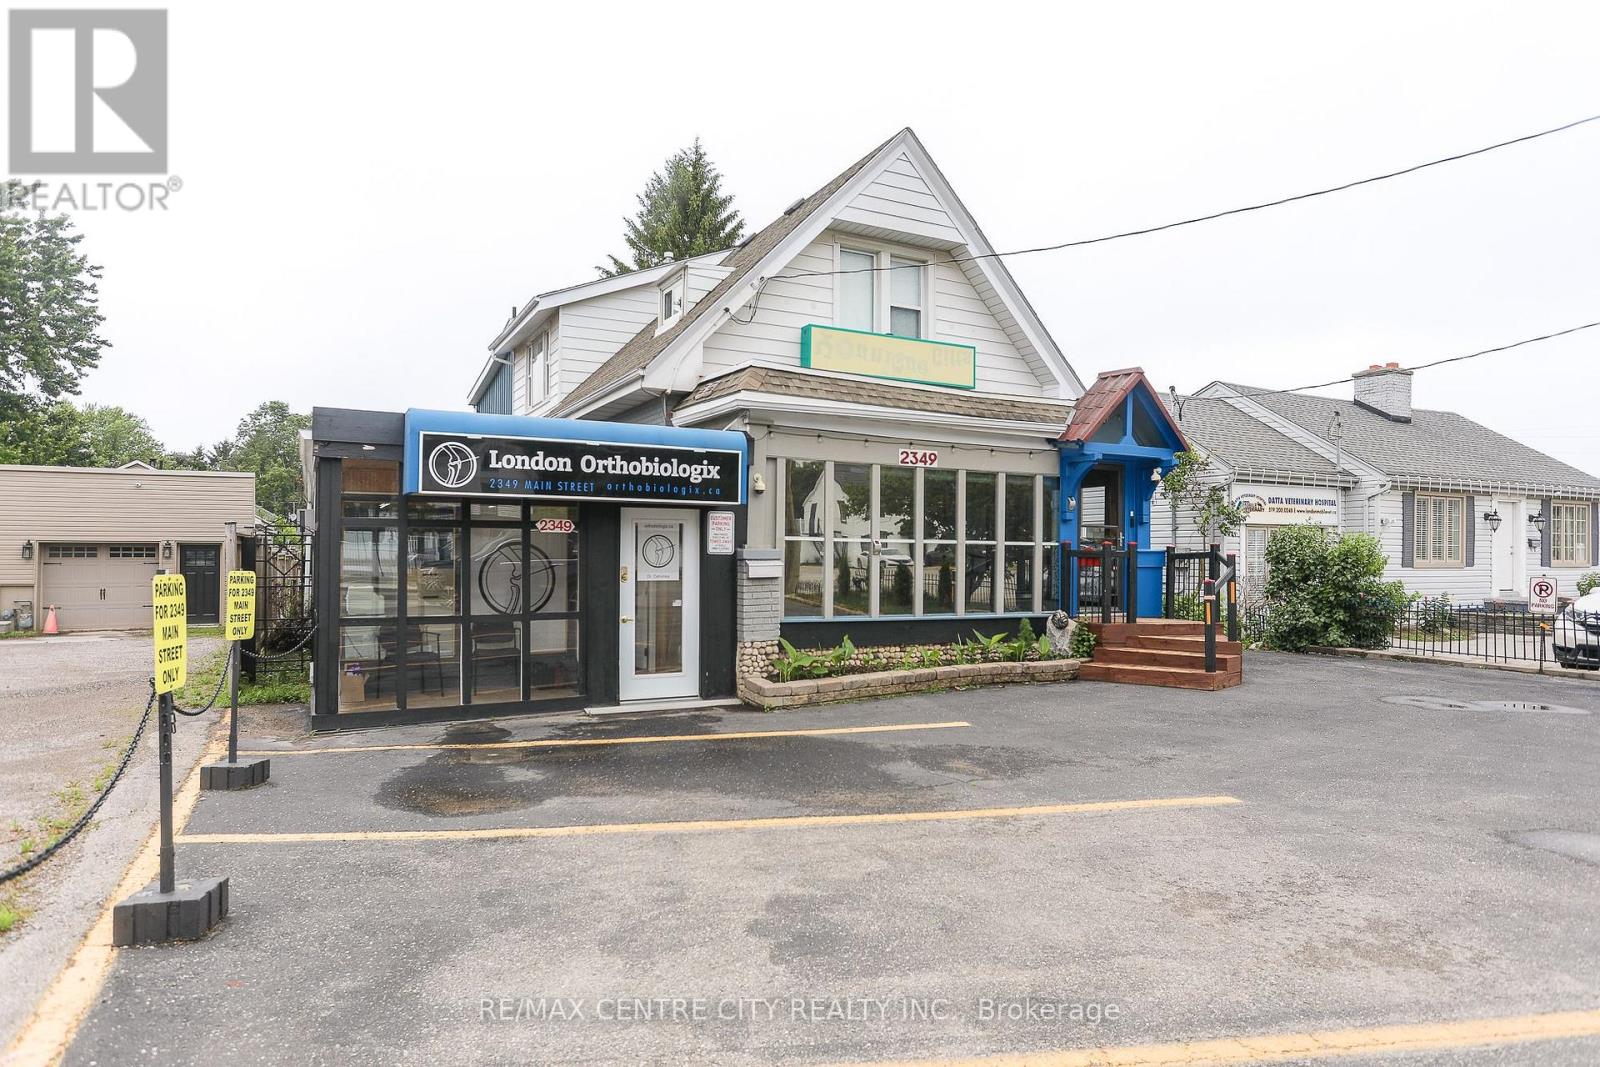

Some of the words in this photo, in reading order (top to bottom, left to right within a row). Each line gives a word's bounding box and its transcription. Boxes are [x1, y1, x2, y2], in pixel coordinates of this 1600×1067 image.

[900, 451, 937, 466] 2349
[489, 449, 572, 472] London
[580, 452, 721, 483] Orthobiologix
[489, 478, 518, 489] 2349
[524, 479, 553, 491] MAIN
[558, 481, 595, 492] STREET
[607, 481, 721, 496] orthobiologix.ca
[1284, 497, 1313, 505] VETERINARY
[1314, 498, 1337, 506] HOSPITAL
[539, 520, 572, 531] 2349
[229, 575, 254, 585] PARKING
[155, 582, 184, 598] PARKING
[228, 588, 240, 597] FOR
[241, 588, 254, 597] 2349
[155, 605, 168, 620] FOR
[169, 602, 185, 618] 2349
[234, 601, 249, 610] MAIN
[230, 613, 252, 623] STREET
[162, 624, 179, 640] MAIN
[232, 626, 248, 635] ONLY
[158, 644, 183, 664] STREET
[162, 666, 180, 684] ONLY
